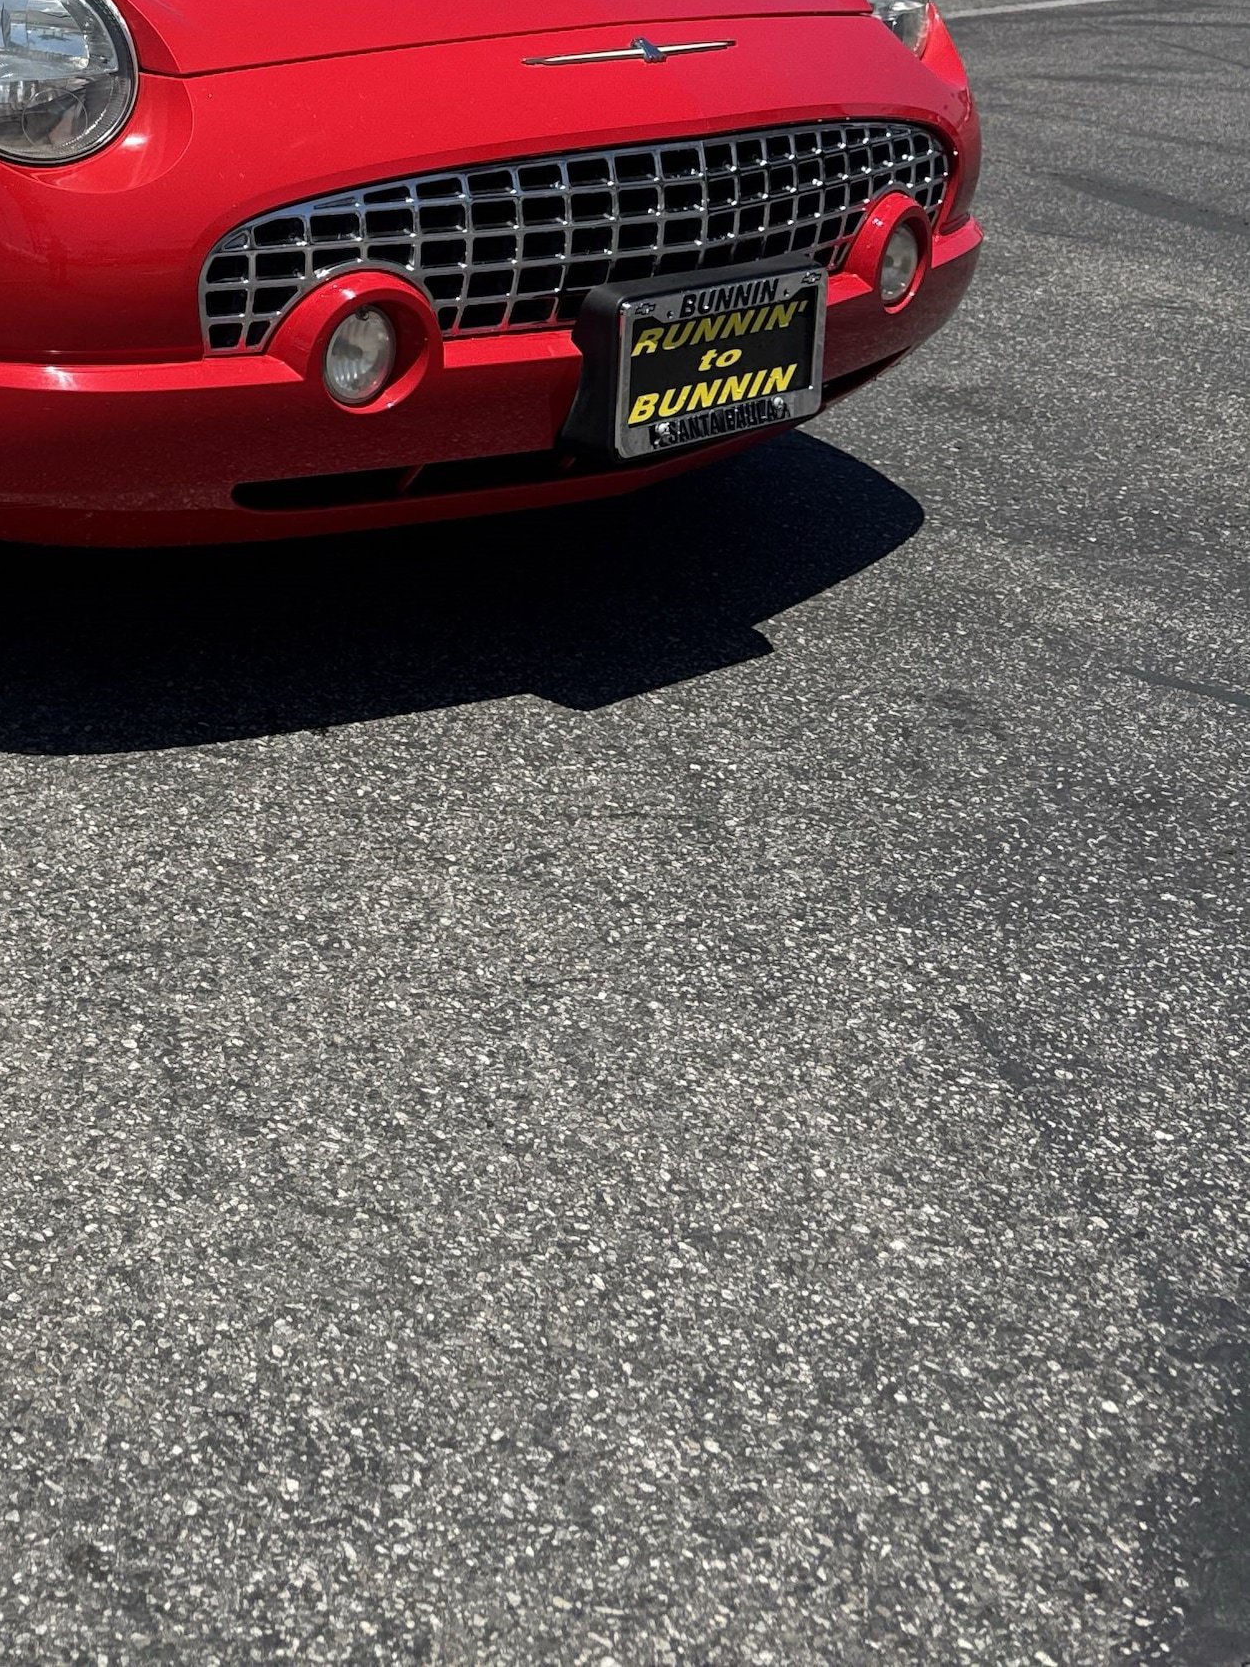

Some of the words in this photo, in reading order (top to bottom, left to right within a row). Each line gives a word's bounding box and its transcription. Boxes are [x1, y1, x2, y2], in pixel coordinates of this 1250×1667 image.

[679, 278, 779, 319] BUNNIN
[630, 300, 809, 358] RUNNIN'
[698, 348, 743, 372] to
[628, 363, 799, 425] BUNNIN
